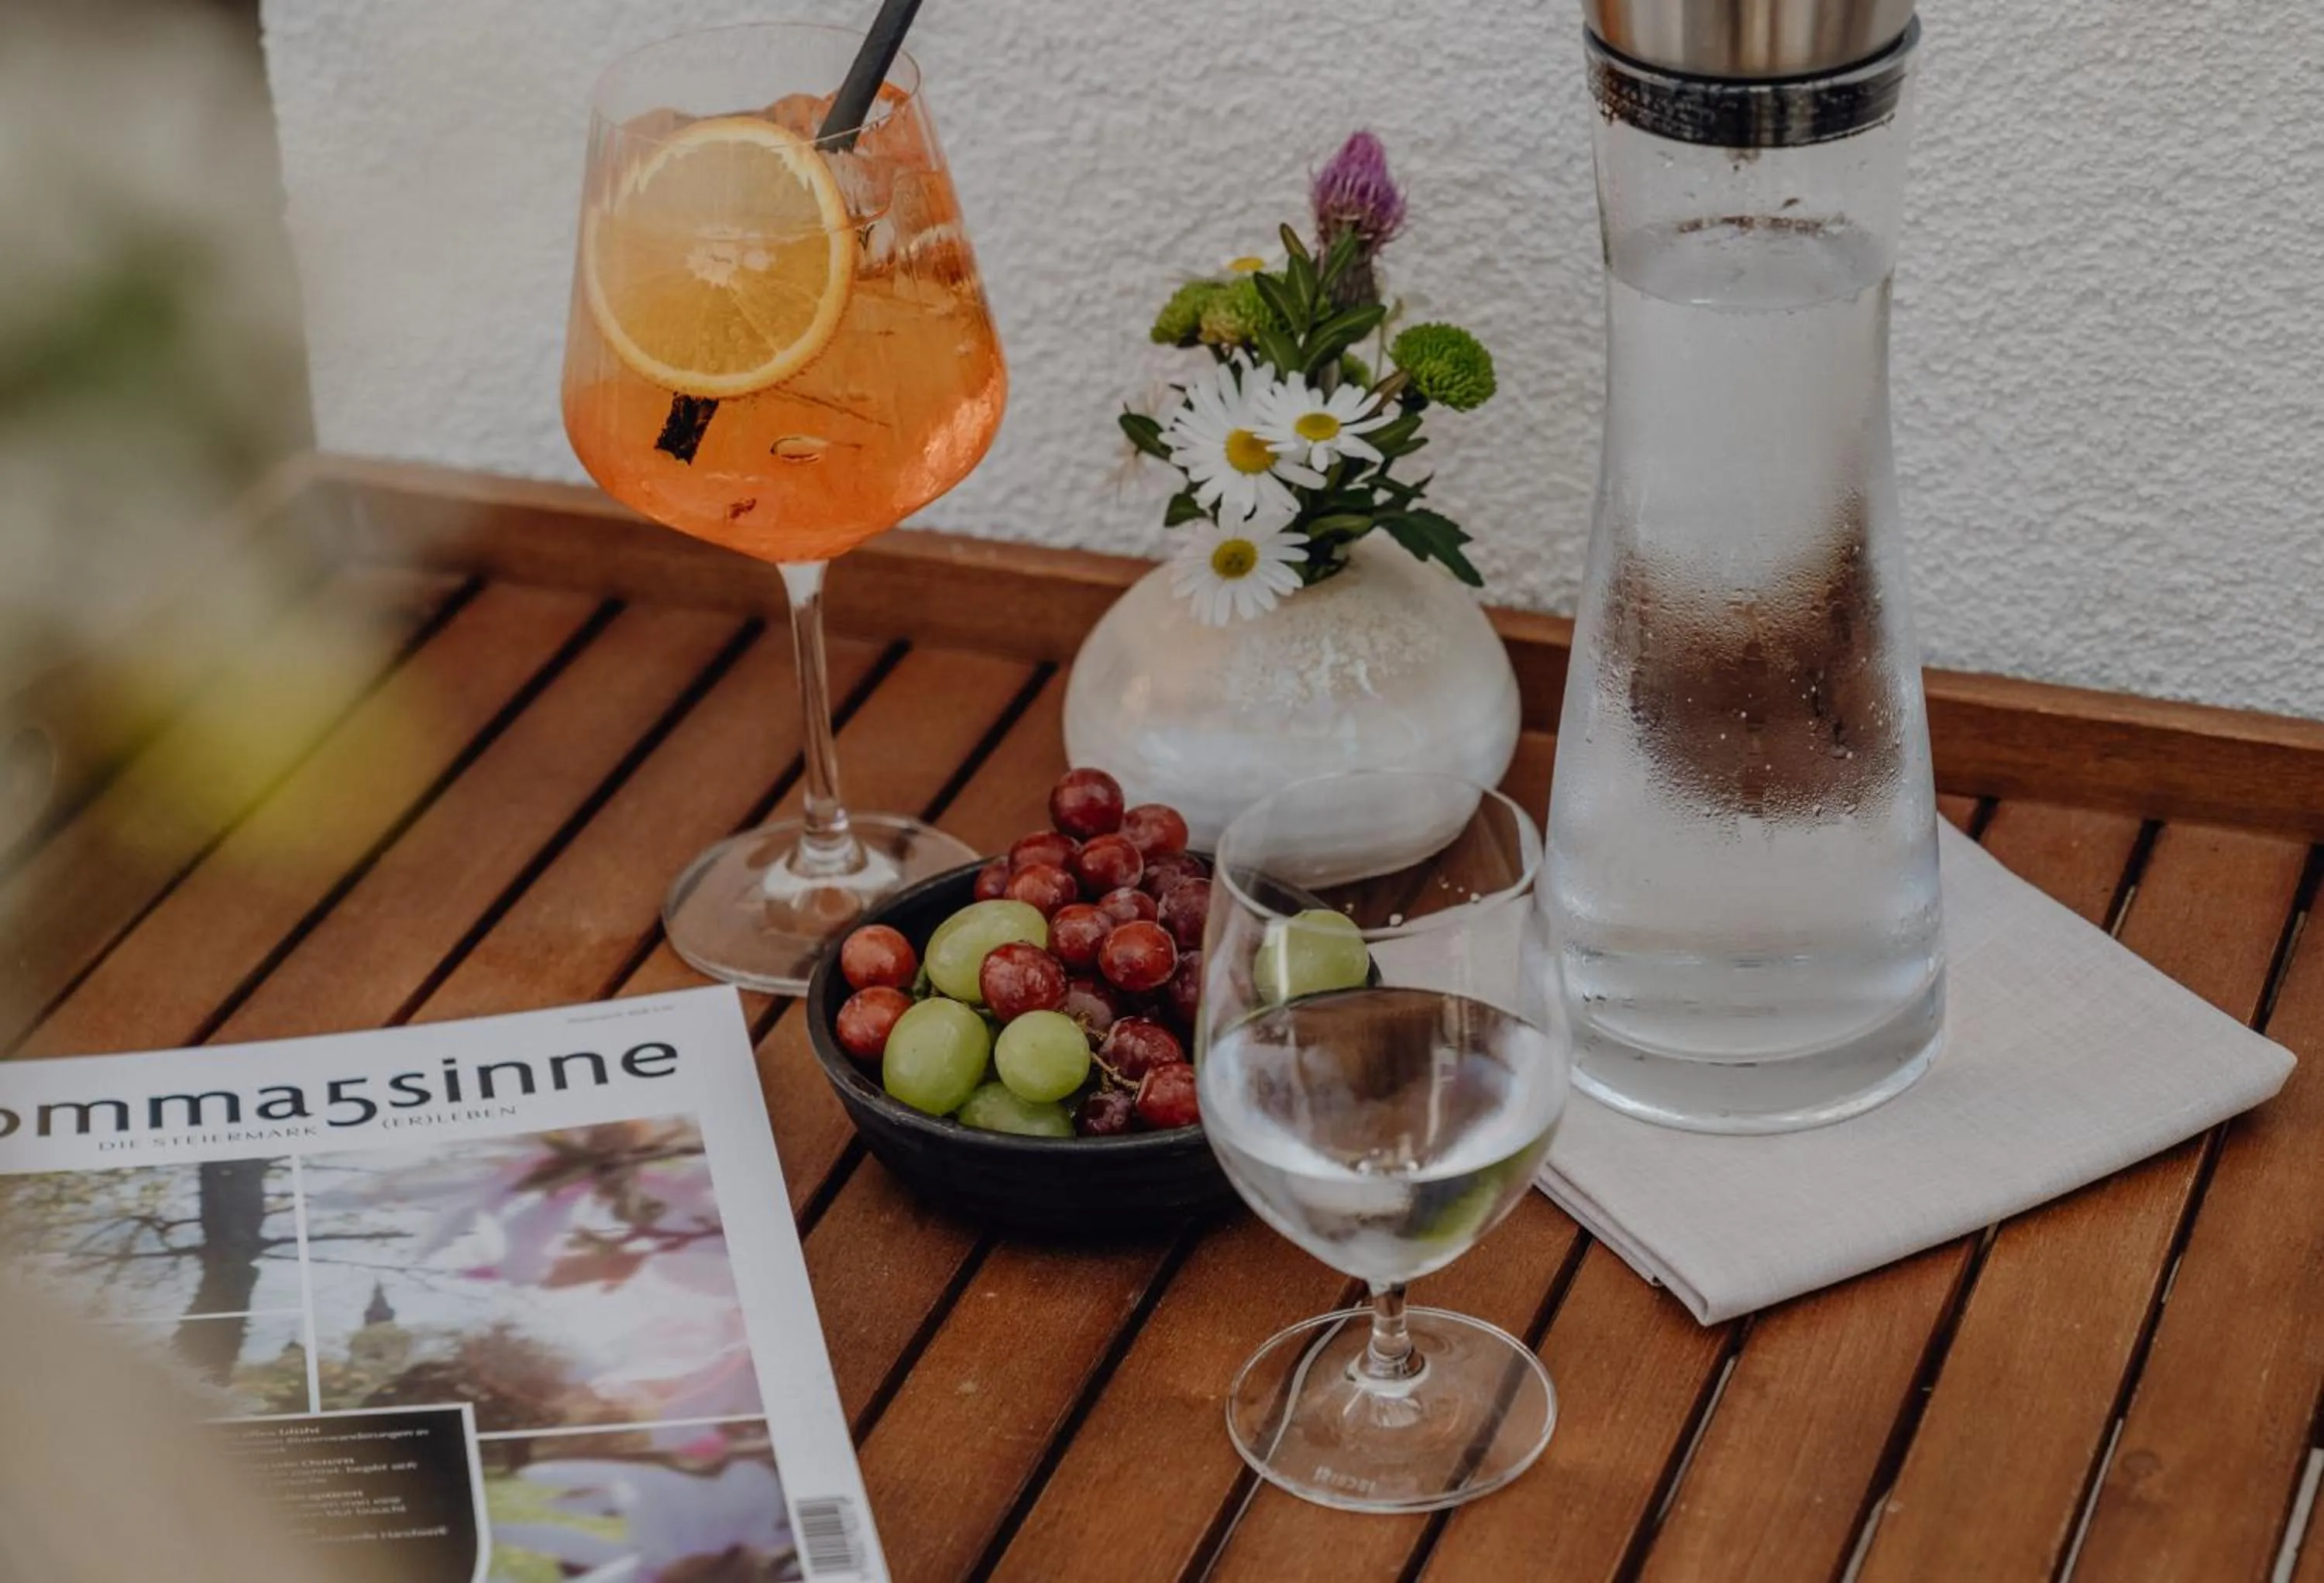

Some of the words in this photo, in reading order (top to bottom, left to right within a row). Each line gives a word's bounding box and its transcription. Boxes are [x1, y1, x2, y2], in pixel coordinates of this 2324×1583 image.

[98, 1138, 137, 1152] DIE
[153, 1127, 318, 1147] STEIERMARK
[382, 1105, 517, 1129] (ER)LEBEN
